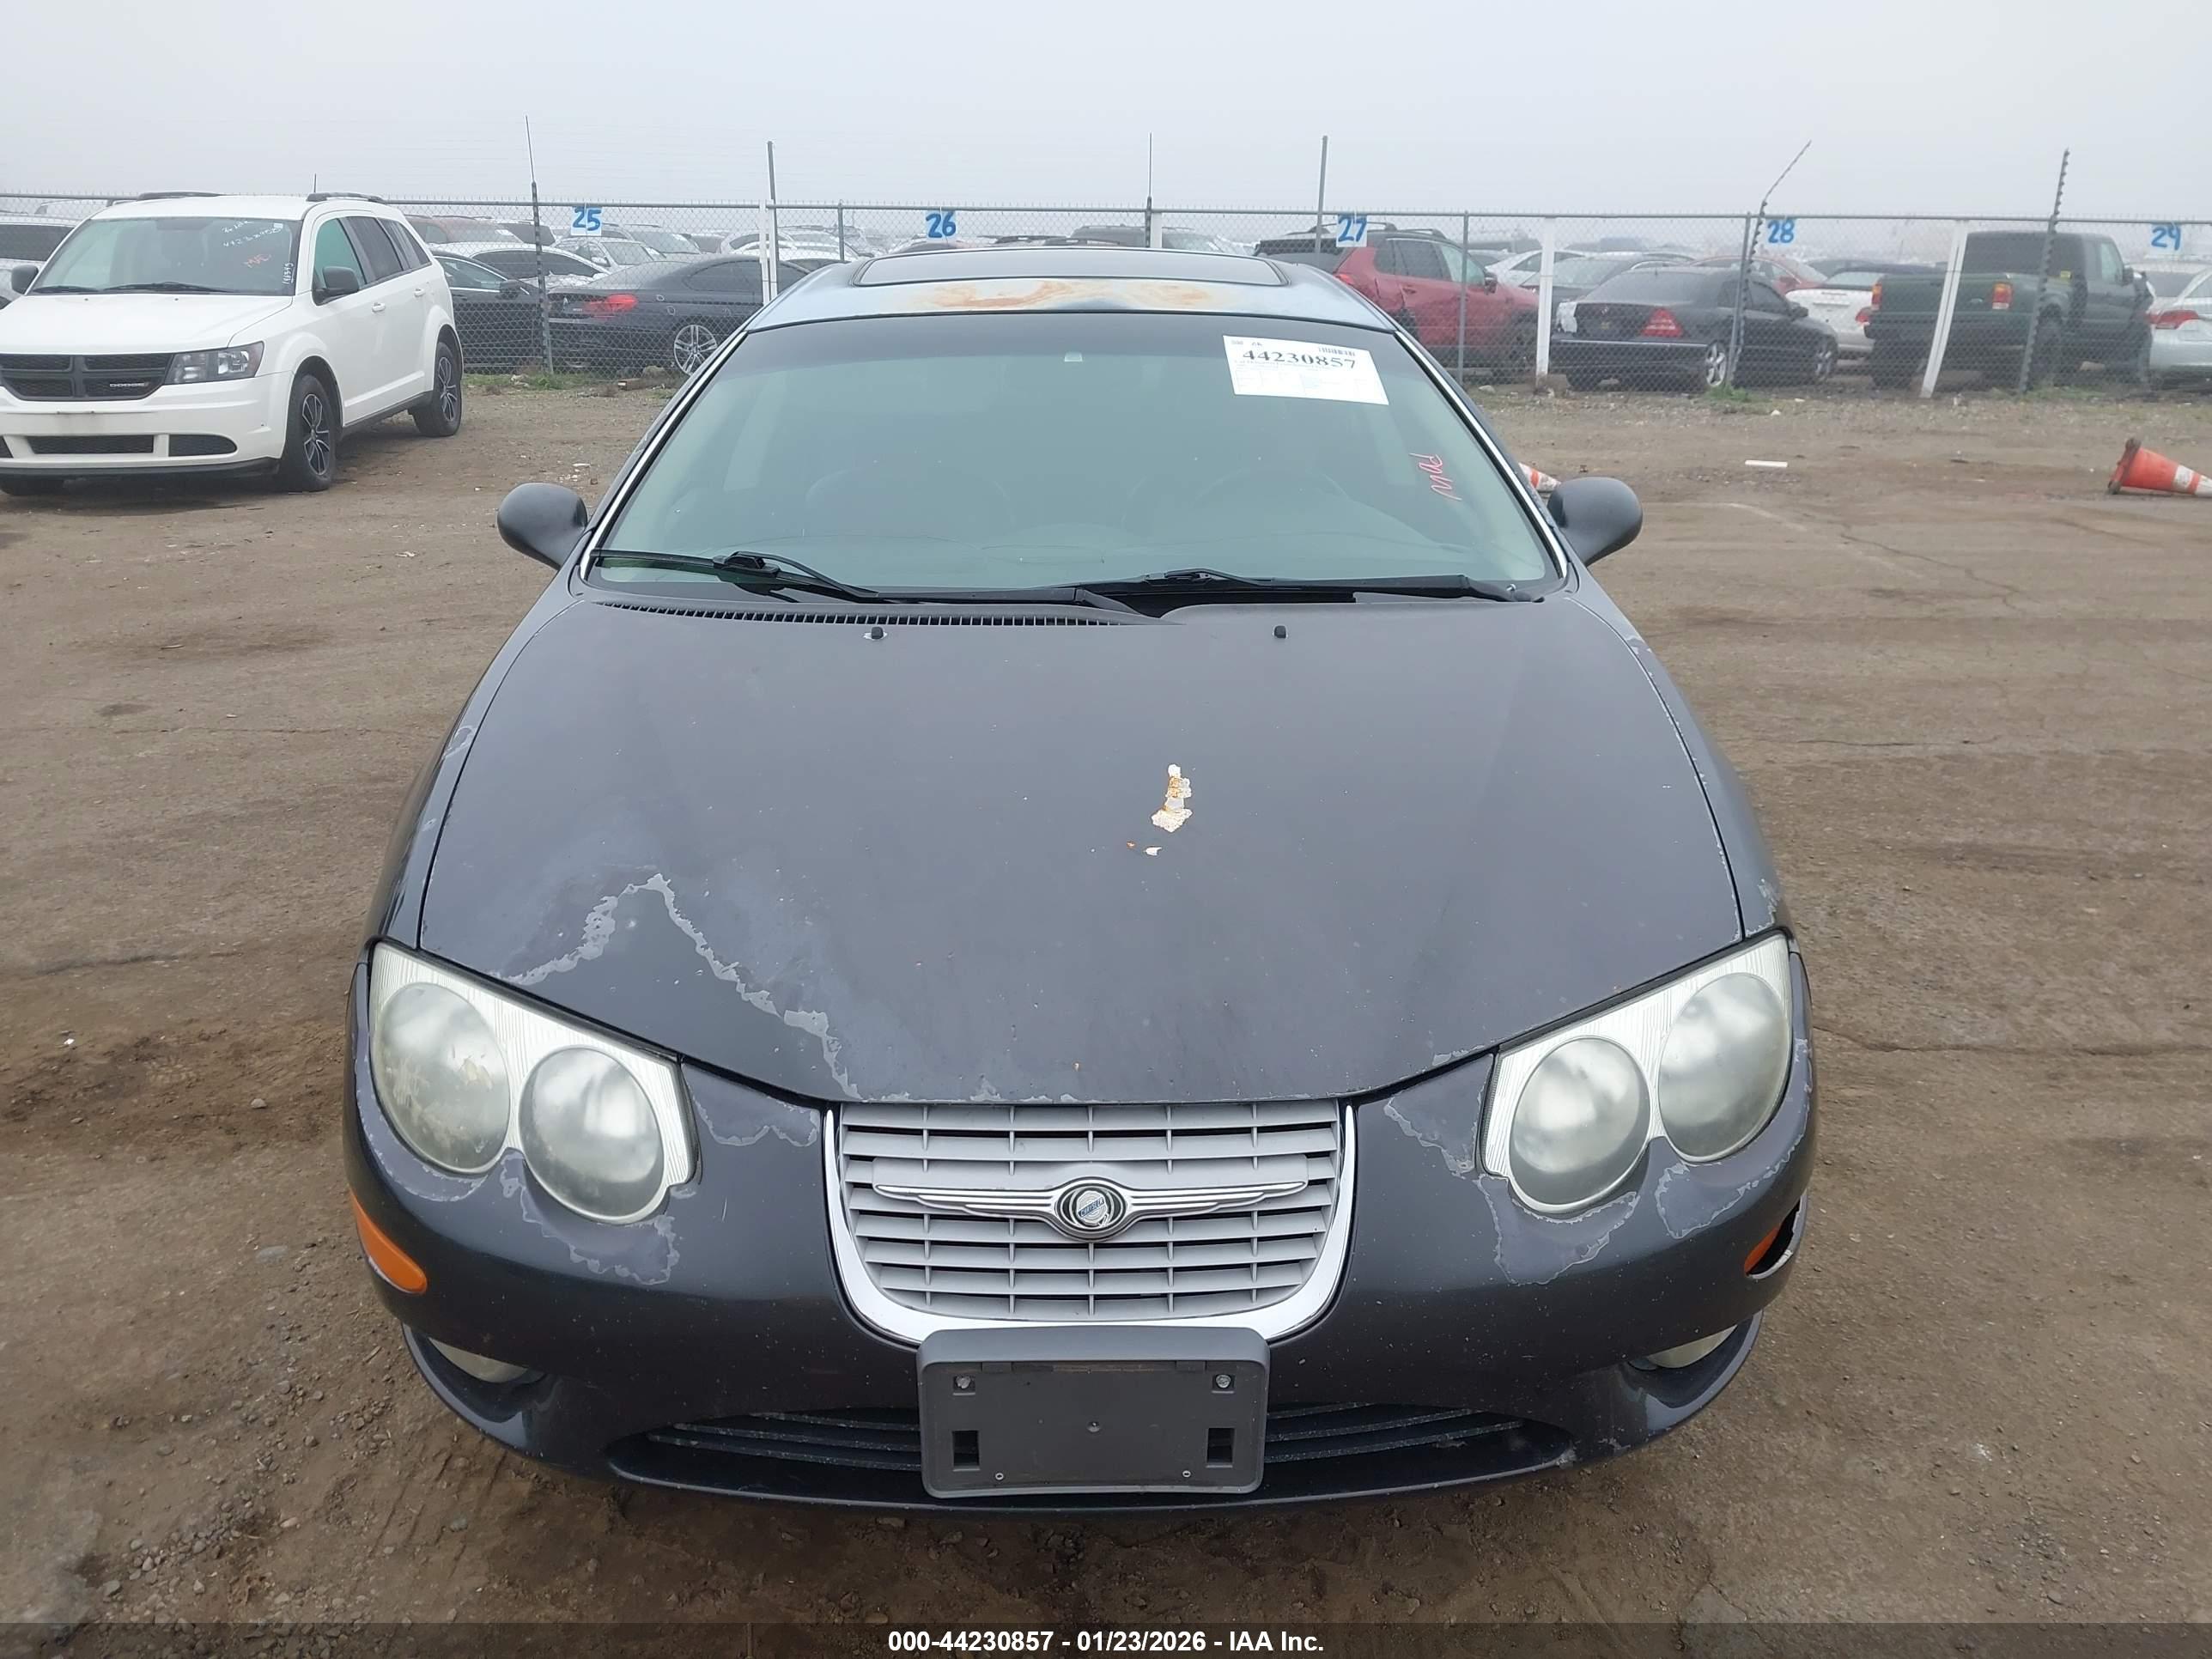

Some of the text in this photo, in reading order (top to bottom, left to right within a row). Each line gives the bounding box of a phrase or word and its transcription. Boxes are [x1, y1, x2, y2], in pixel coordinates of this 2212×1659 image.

[572, 206, 602, 231] 25
[926, 210, 957, 238] 26
[1338, 214, 1367, 242] 27
[1767, 218, 1795, 243] 28
[1243, 349, 1356, 369] 44230857
